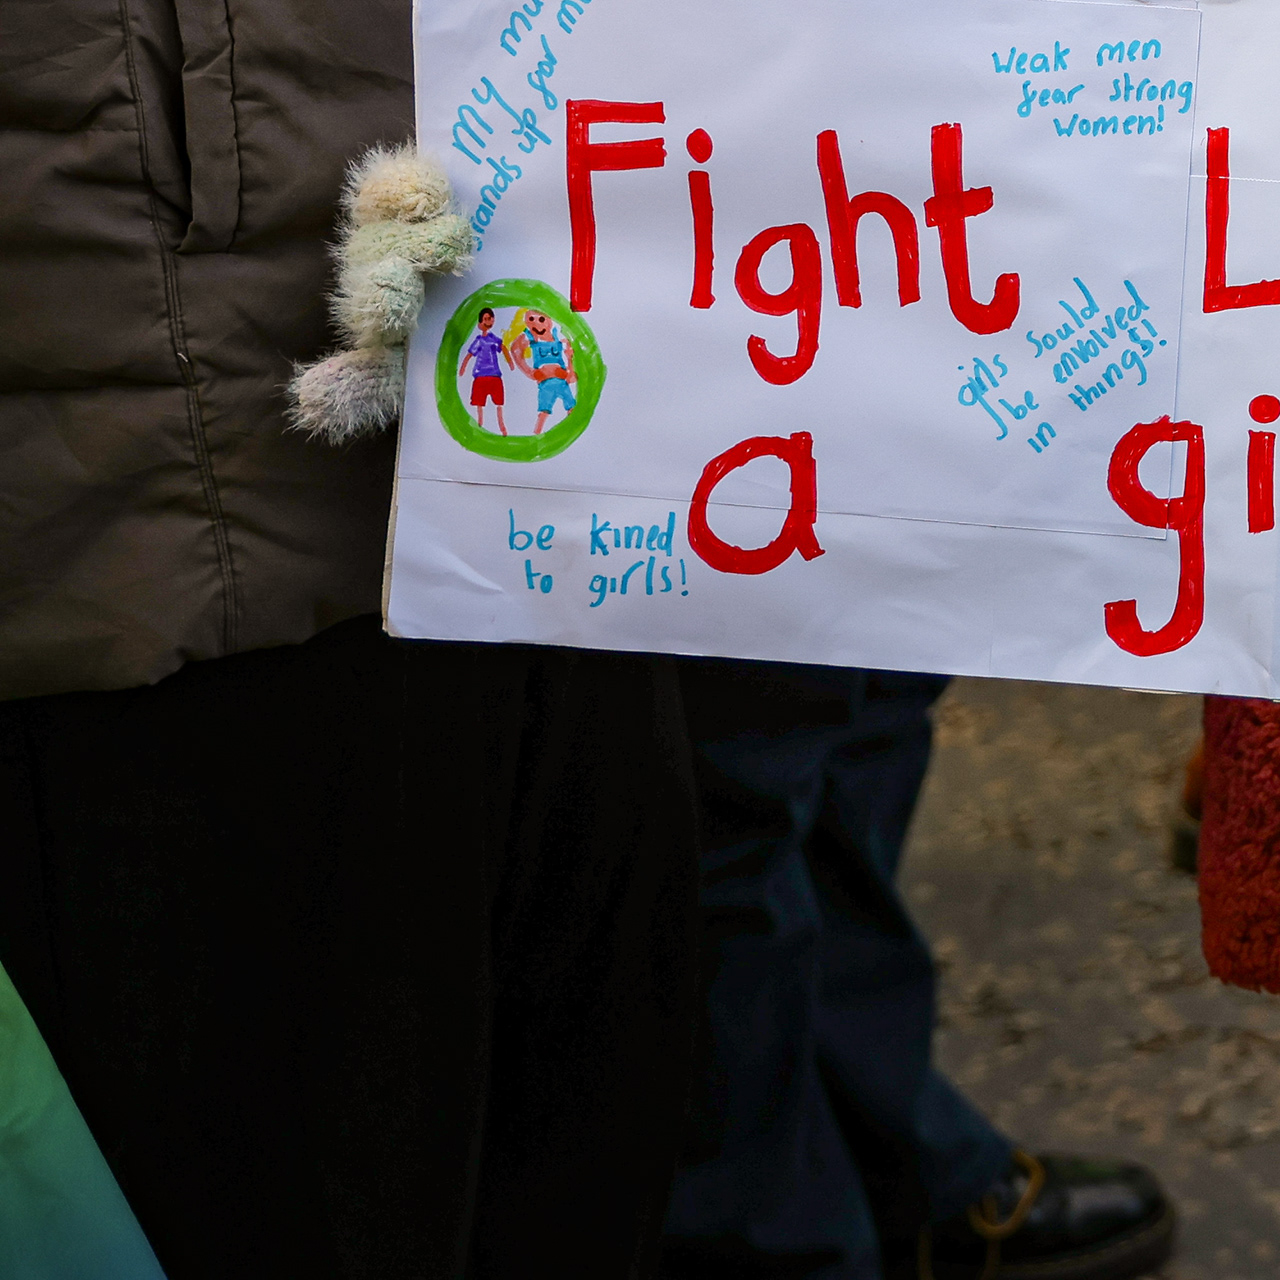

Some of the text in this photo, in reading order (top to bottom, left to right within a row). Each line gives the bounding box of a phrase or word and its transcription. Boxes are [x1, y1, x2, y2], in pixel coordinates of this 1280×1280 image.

[528, 35, 558, 116] for
[1097, 39, 1161, 66] men
[518, 105, 556, 153] up
[1017, 73, 1192, 117] fear strong
[566, 100, 1019, 385] Fight
[998, 280, 1150, 420] be envolved
[1026, 277, 1100, 358] sould
[1027, 319, 1167, 453] in things!
[509, 509, 676, 557] be kined
[689, 432, 824, 574] a
[525, 556, 688, 607] to girls!
